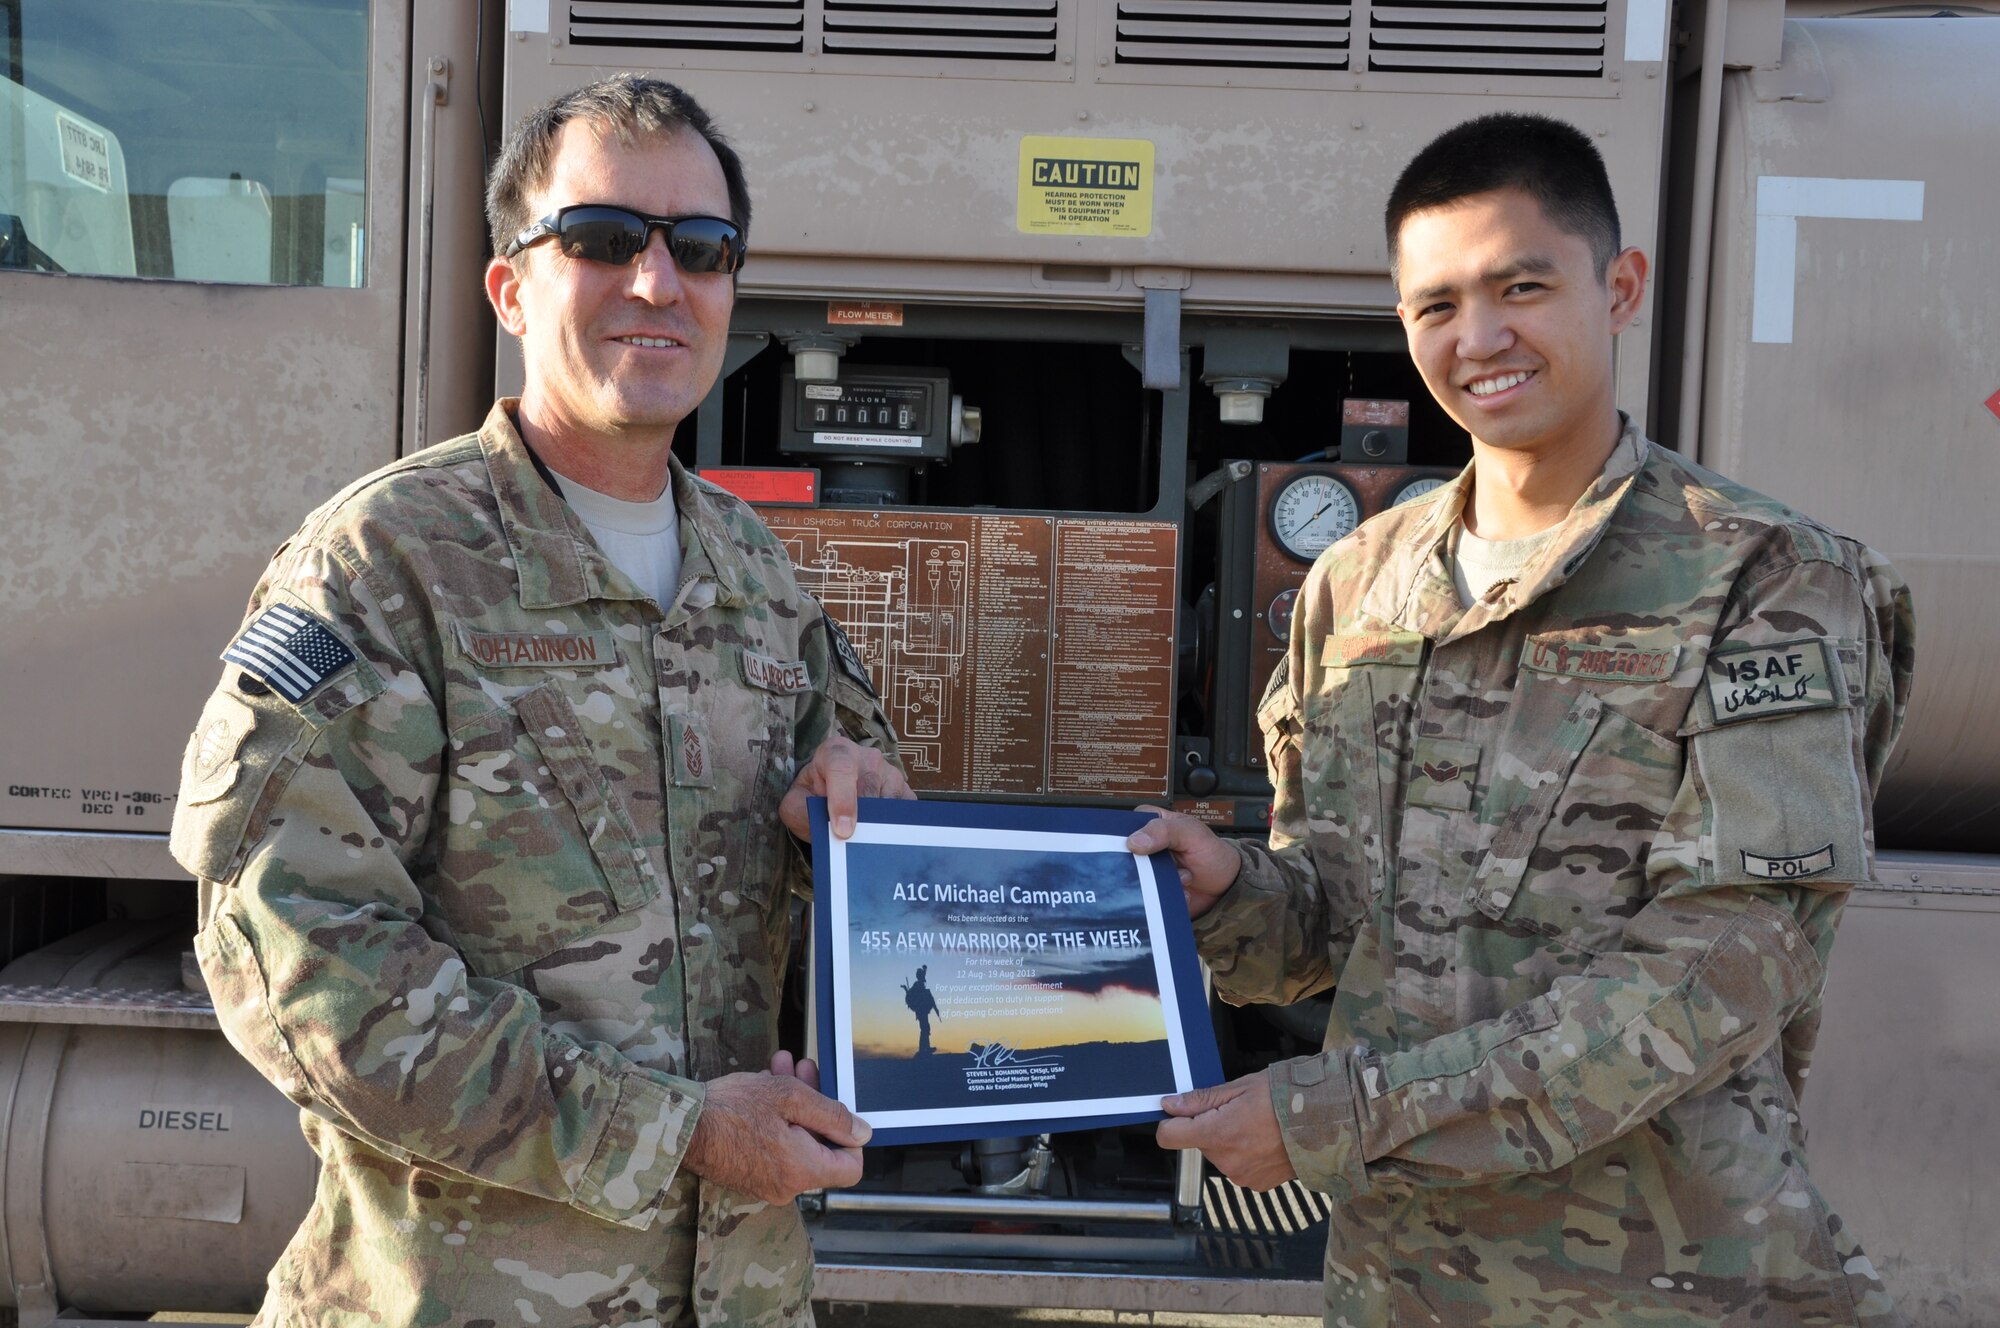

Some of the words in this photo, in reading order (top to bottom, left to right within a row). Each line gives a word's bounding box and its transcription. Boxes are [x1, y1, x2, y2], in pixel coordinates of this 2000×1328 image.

[1035, 162, 1137, 186] CAUTION
[1045, 191, 1078, 199] HEARING
[1079, 192, 1126, 200] PROTECTION
[1068, 207, 1110, 215] EQUIPMENT
[838, 311, 862, 319] FLOW
[864, 312, 893, 320] METER
[1314, 487, 1320, 495] 50
[1324, 491, 1331, 499] 60
[803, 518, 846, 527] OSHKOSH
[852, 519, 881, 528] TRUCK
[887, 521, 953, 530] CORPORATION
[1327, 530, 1337, 538] 100
[1577, 649, 1611, 675] AIR
[1614, 652, 1670, 676] FORCE
[1727, 654, 1803, 684] ISAF
[9, 785, 71, 799] CORTEC
[82, 803, 113, 814] DEC
[126, 805, 144, 815] 10
[1768, 861, 1810, 876] POL
[893, 883, 929, 902] A1C
[934, 884, 1005, 904] Michael
[1010, 886, 1097, 908] Campana
[947, 914, 960, 922] Has
[962, 914, 978, 922] been
[979, 914, 1007, 923] selected
[1017, 915, 1029, 923] the
[861, 931, 891, 949] 455
[896, 931, 934, 949] AEW
[939, 932, 1021, 950] WARRIOR
[1025, 932, 1048, 949] OF
[1052, 931, 1086, 949] THE
[1090, 929, 1142, 948] WEEK
[965, 957, 978, 966] For
[980, 957, 992, 966] the
[993, 957, 1014, 966] week
[1015, 957, 1025, 967] of
[957, 970, 966, 978] 12
[988, 970, 998, 978] 19
[999, 970, 1015, 980] Aug
[1016, 969, 1036, 978] 2013
[935, 983, 948, 992] For
[949, 985, 967, 993] your
[968, 982, 1012, 993] exceptional
[1013, 981, 1063, 991] commitment
[937, 996, 952, 1005] and
[953, 995, 994, 1004] dedication
[995, 995, 1004, 1004] to
[1005, 994, 1023, 1006] duty
[1024, 995, 1032, 1003] in
[1033, 994, 1065, 1004] support
[941, 1008, 950, 1018] of
[950, 1008, 986, 1018] on-going
[987, 1006, 1018, 1016] Combat
[1019, 1005, 1064, 1016] Operations
[966, 1070, 988, 1078] STEVEN
[967, 1077, 995, 1085] Command
[1030, 1074, 1056, 1082] Sergeant
[994, 1082, 1032, 1090] Expeditionary
[139, 1109, 230, 1131] DIESEL
